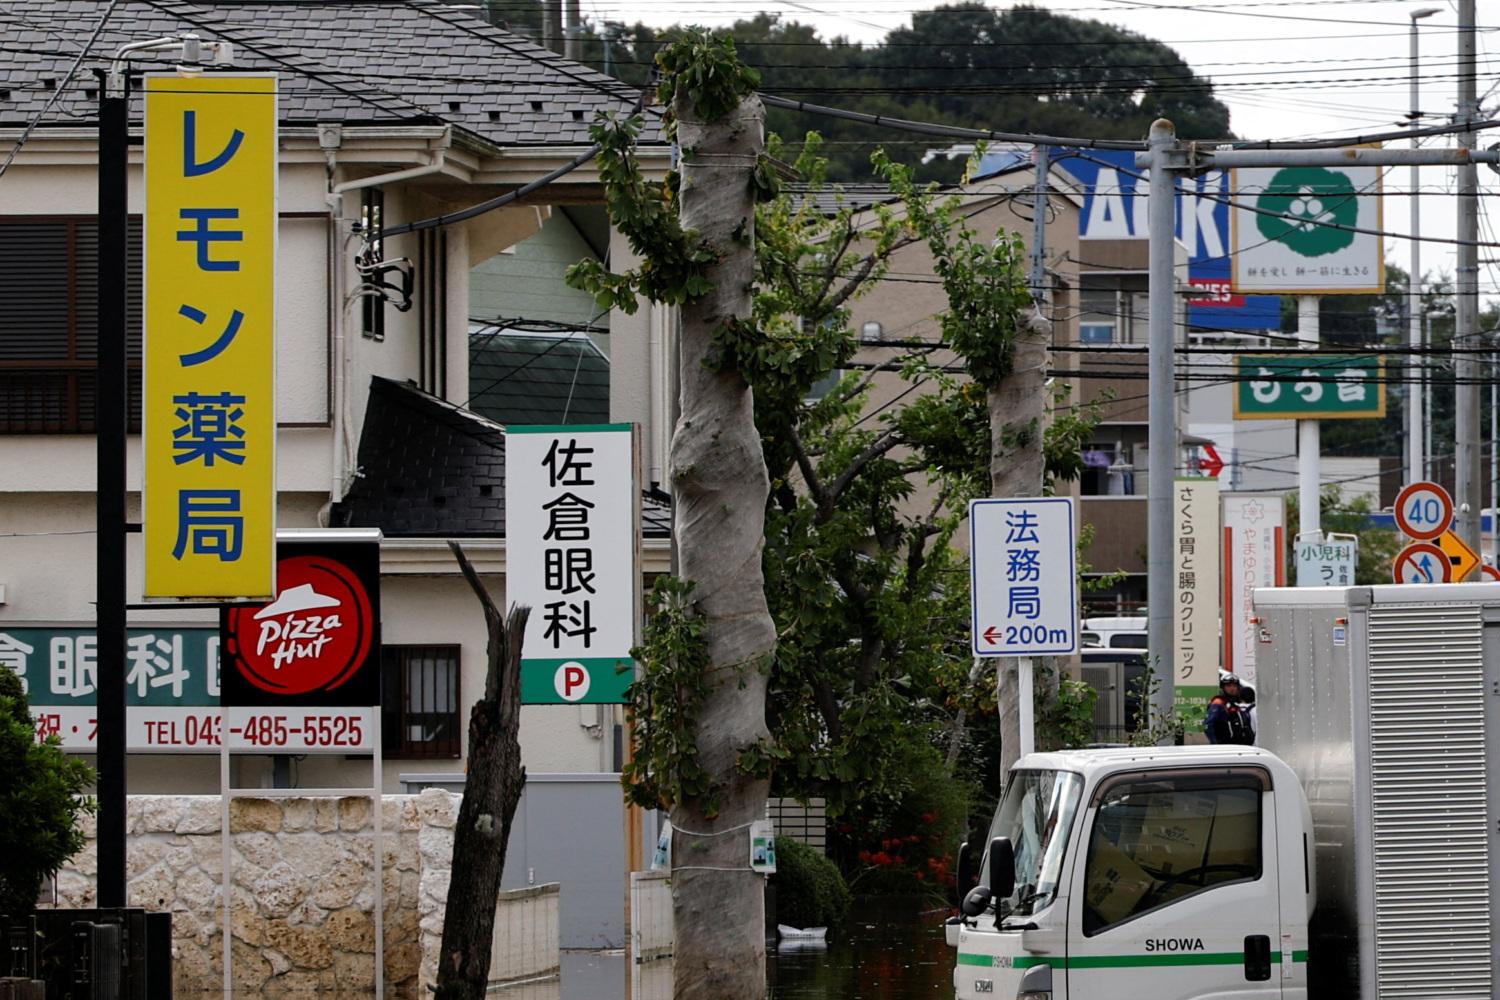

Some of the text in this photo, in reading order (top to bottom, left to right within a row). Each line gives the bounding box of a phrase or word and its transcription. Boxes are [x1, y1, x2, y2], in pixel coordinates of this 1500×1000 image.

[171, 110, 247, 563] レモン薬局
[1408, 499, 1439, 524] 40
[541, 438, 597, 649] 佐倉眼科
[1301, 544, 1350, 561] 小児科
[1005, 510, 1041, 620] 法務局
[1179, 486, 1196, 680] さくら胃と腸のクリニック
[257, 612, 342, 656] Pizza
[1006, 625, 1067, 645] 200m
[271, 634, 333, 670] Hut
[563, 666, 585, 697] P
[144, 721, 181, 744] TEL
[1145, 938, 1205, 951] SHOWA
